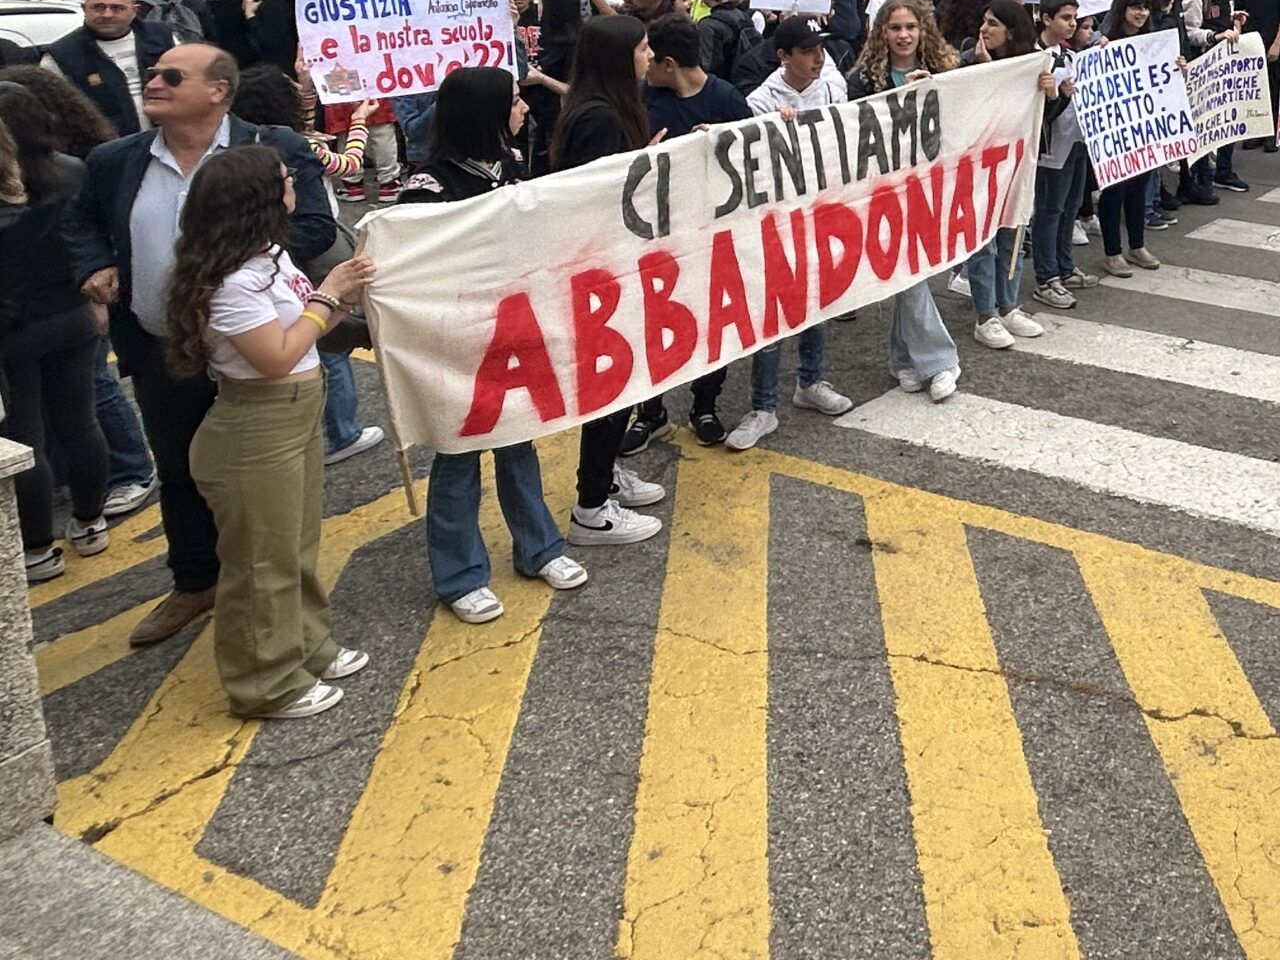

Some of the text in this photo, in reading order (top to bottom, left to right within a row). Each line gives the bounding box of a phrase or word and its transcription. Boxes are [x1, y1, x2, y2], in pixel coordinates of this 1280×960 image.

[349, 25, 371, 54] la
[376, 19, 433, 51] nostra
[441, 16, 493, 45] scuola
[1226, 40, 1239, 56] IL
[1075, 44, 1136, 80] SAPPIAMO
[1073, 79, 1106, 111] COSA
[1105, 69, 1144, 100] DEVE
[1206, 88, 1261, 110] APPARTIENE
[1103, 126, 1131, 157] CHE
[1131, 110, 1193, 148] MANCA
[1206, 112, 1221, 130] CHE
[1224, 108, 1237, 123] LO
[622, 88, 941, 240] CI SENTIAMO
[1163, 138, 1197, 160] FARLO
[460, 138, 1024, 437] ABBANDONATI
